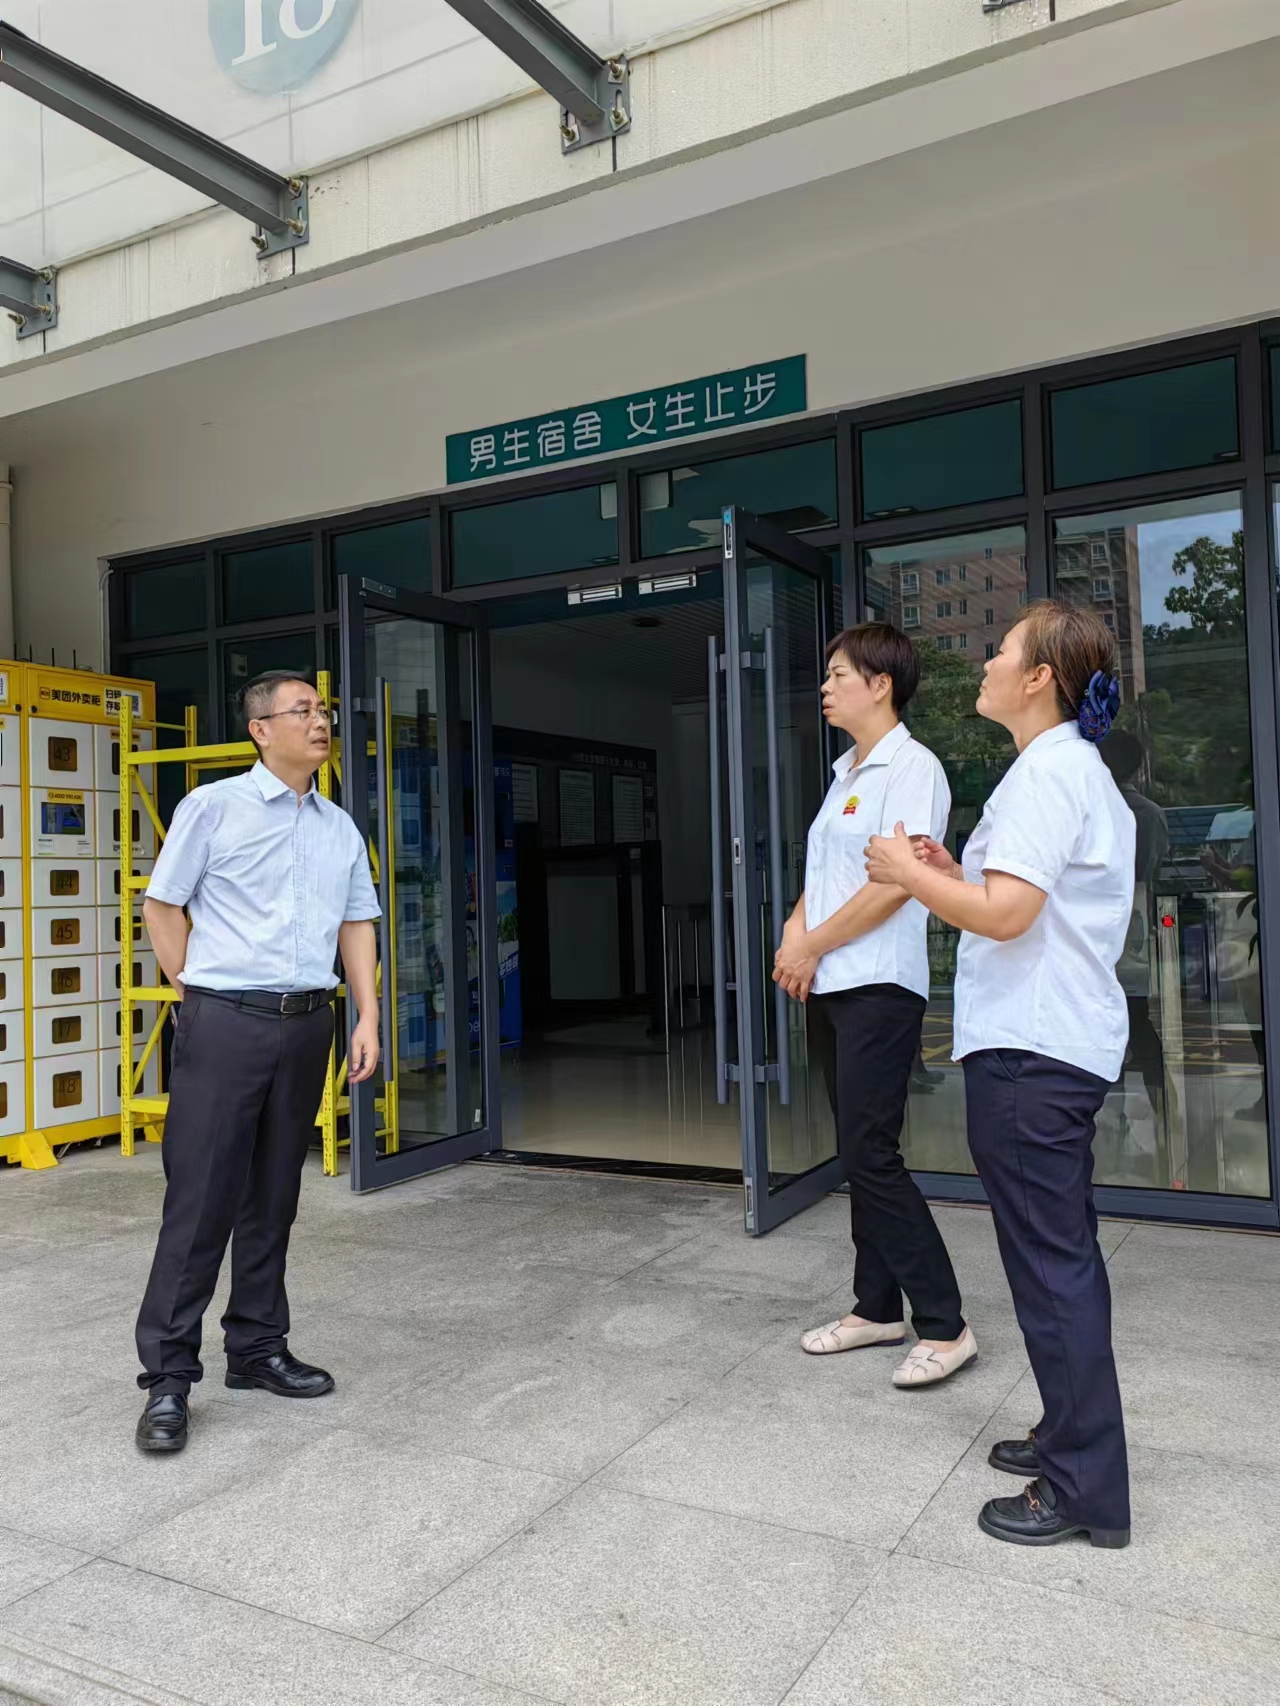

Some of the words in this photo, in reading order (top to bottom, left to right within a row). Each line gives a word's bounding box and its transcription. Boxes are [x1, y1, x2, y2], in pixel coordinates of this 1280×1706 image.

[470, 411, 602, 473] 男生宿舍
[626, 372, 777, 440] 女生止步
[51, 689, 101, 706] 美团外卖柜
[105, 689, 122, 698] 扫码
[57, 924, 73, 940] 45
[58, 1078, 76, 1094] 48
